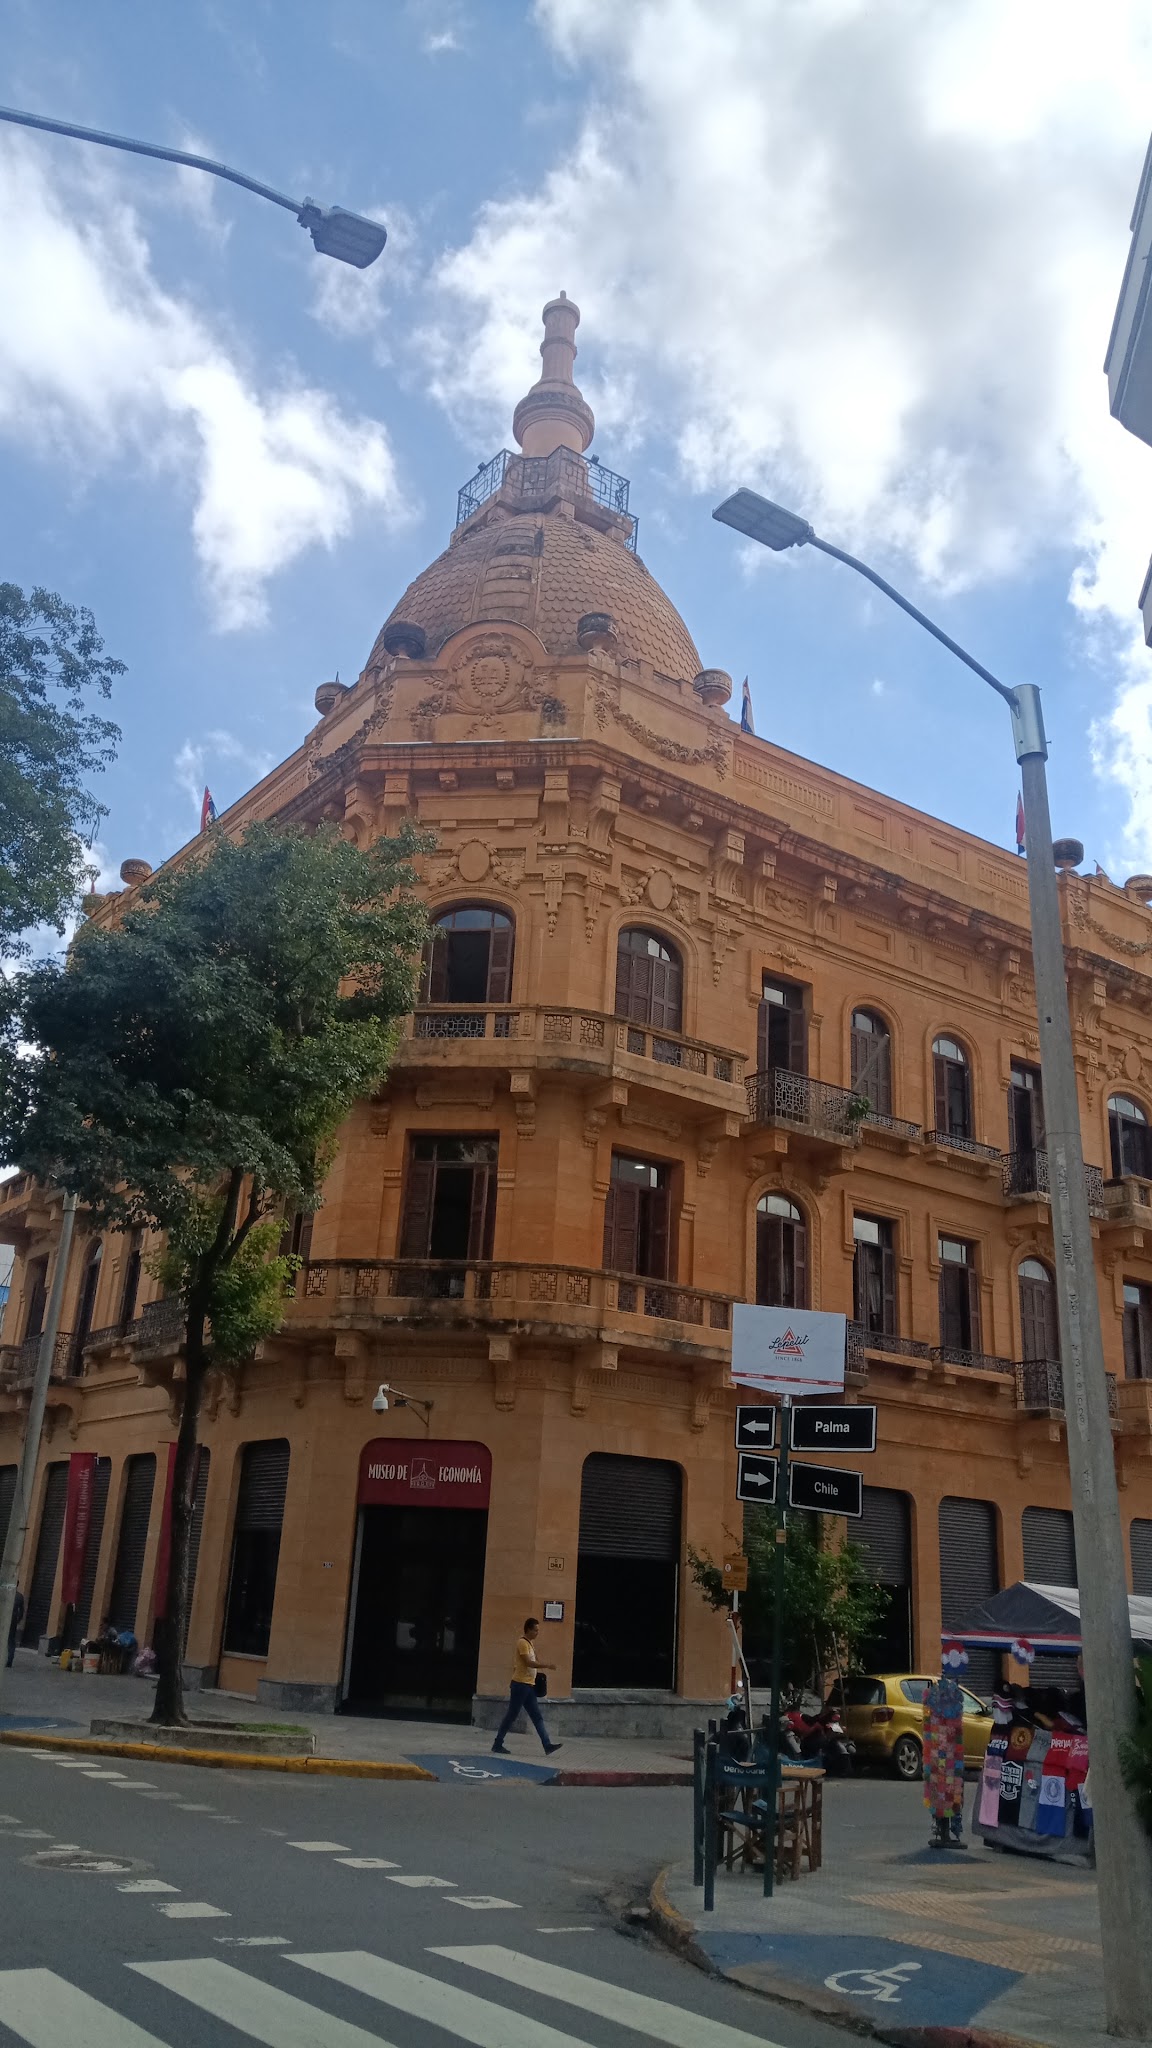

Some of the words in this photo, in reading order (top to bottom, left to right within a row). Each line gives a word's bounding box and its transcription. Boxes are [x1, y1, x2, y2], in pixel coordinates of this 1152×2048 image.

[768, 1334, 810, 1350] Lepetit
[815, 1421, 850, 1433] Palma
[368, 1464, 396, 1479] MUSEO
[397, 1465, 408, 1480] DE
[438, 1466, 482, 1483] ECONOMÍA
[814, 1481, 839, 1496] Chile
[76, 1522, 86, 1548] MUSEO
